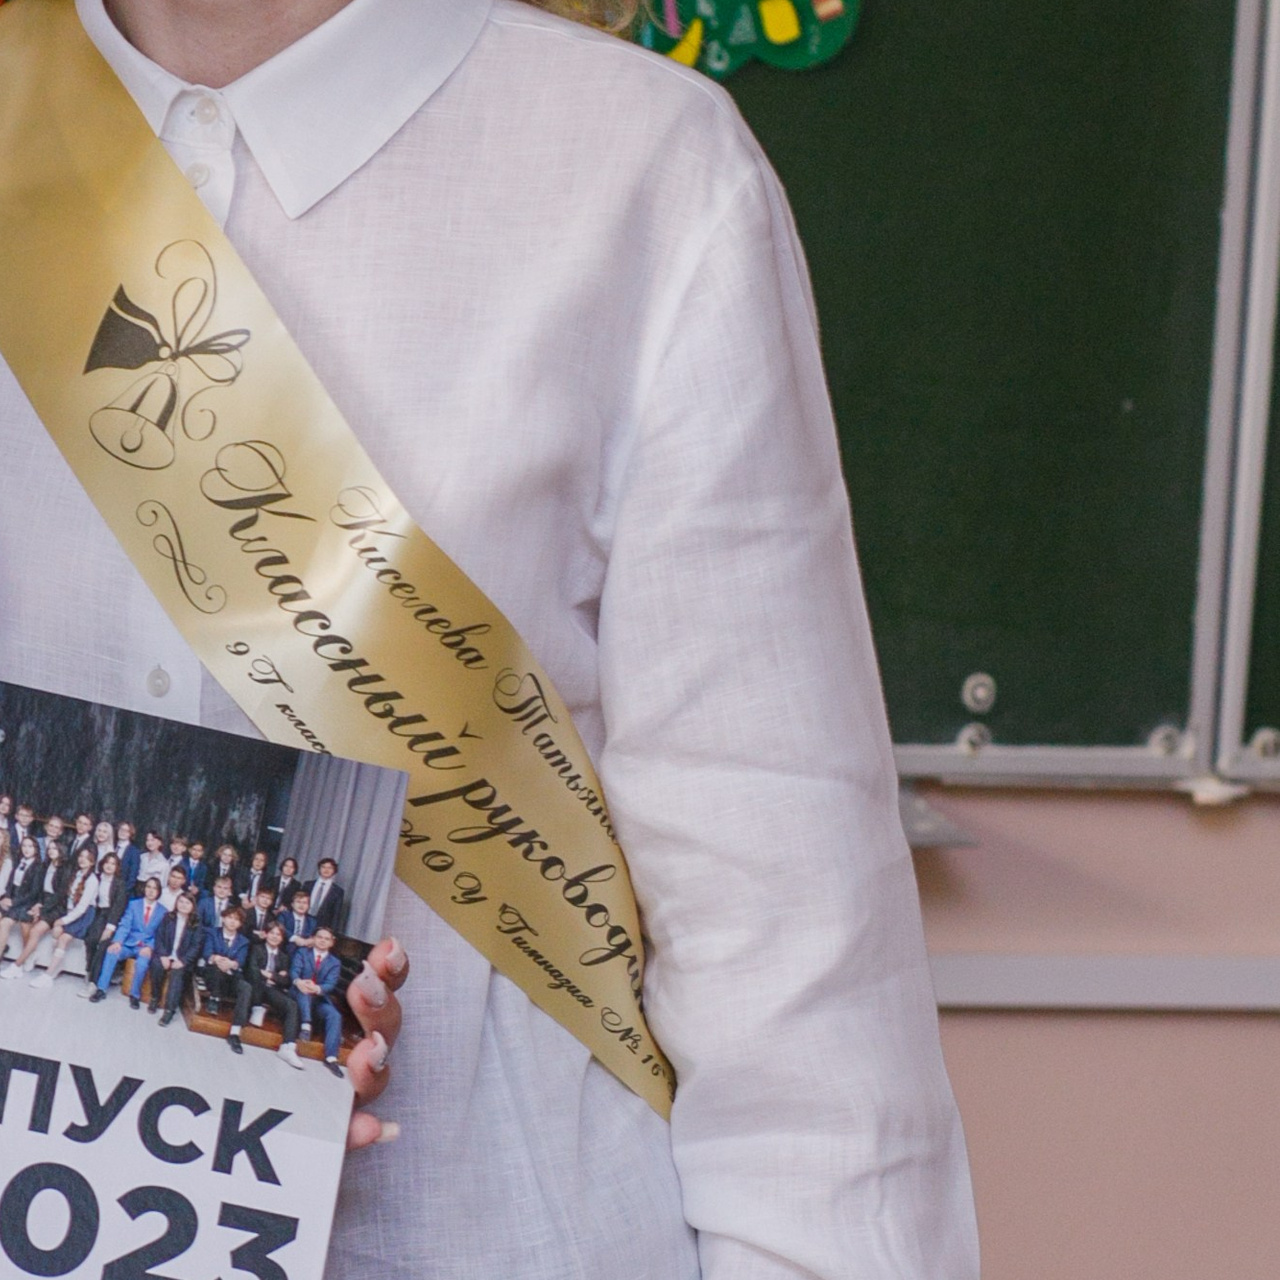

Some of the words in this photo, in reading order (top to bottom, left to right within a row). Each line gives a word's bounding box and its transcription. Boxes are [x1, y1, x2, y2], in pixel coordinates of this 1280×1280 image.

[225, 640, 251, 657] 9
[328, 485, 492, 670] Киселева
[199, 439, 484, 771] Классный
[407, 778, 644, 1014] руководи
